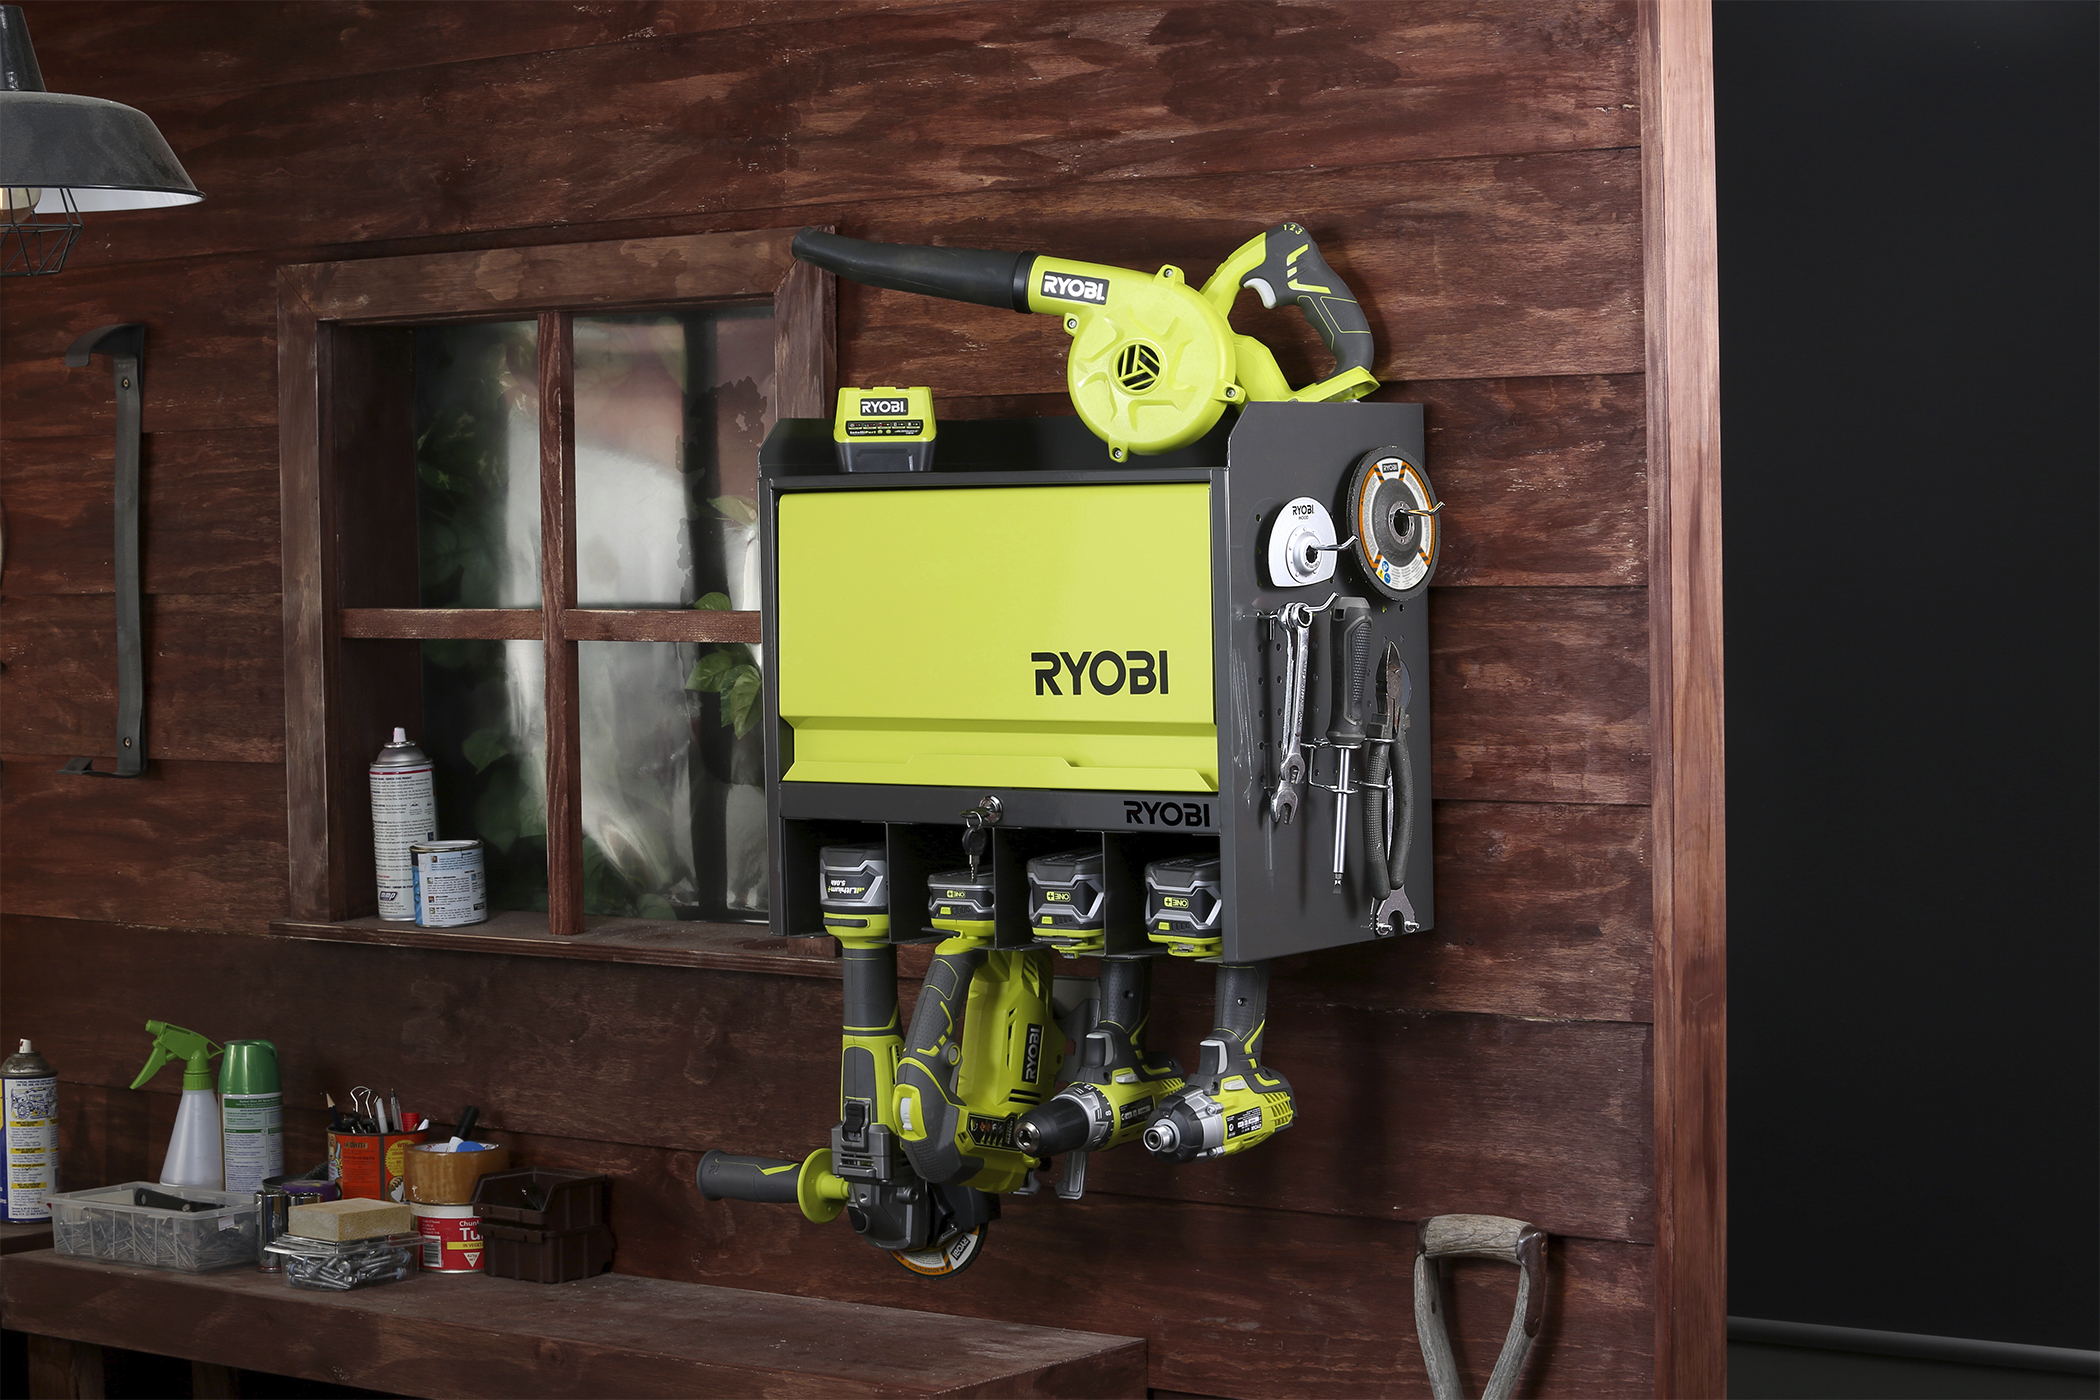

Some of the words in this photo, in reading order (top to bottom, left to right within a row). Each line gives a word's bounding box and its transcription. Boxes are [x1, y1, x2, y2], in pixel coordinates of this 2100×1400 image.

[1295, 227, 1303, 236] 3
[1043, 274, 1105, 301] RYOBI
[861, 400, 904, 413] RYOBI
[1383, 463, 1398, 472] RYOBI
[1292, 504, 1314, 516] RYOBI
[1030, 650, 1169, 696] RYOBI
[1123, 800, 1210, 828] RYOBI
[1026, 1027, 1042, 1081] RYOBI
[951, 1236, 970, 1259] RYOBI
